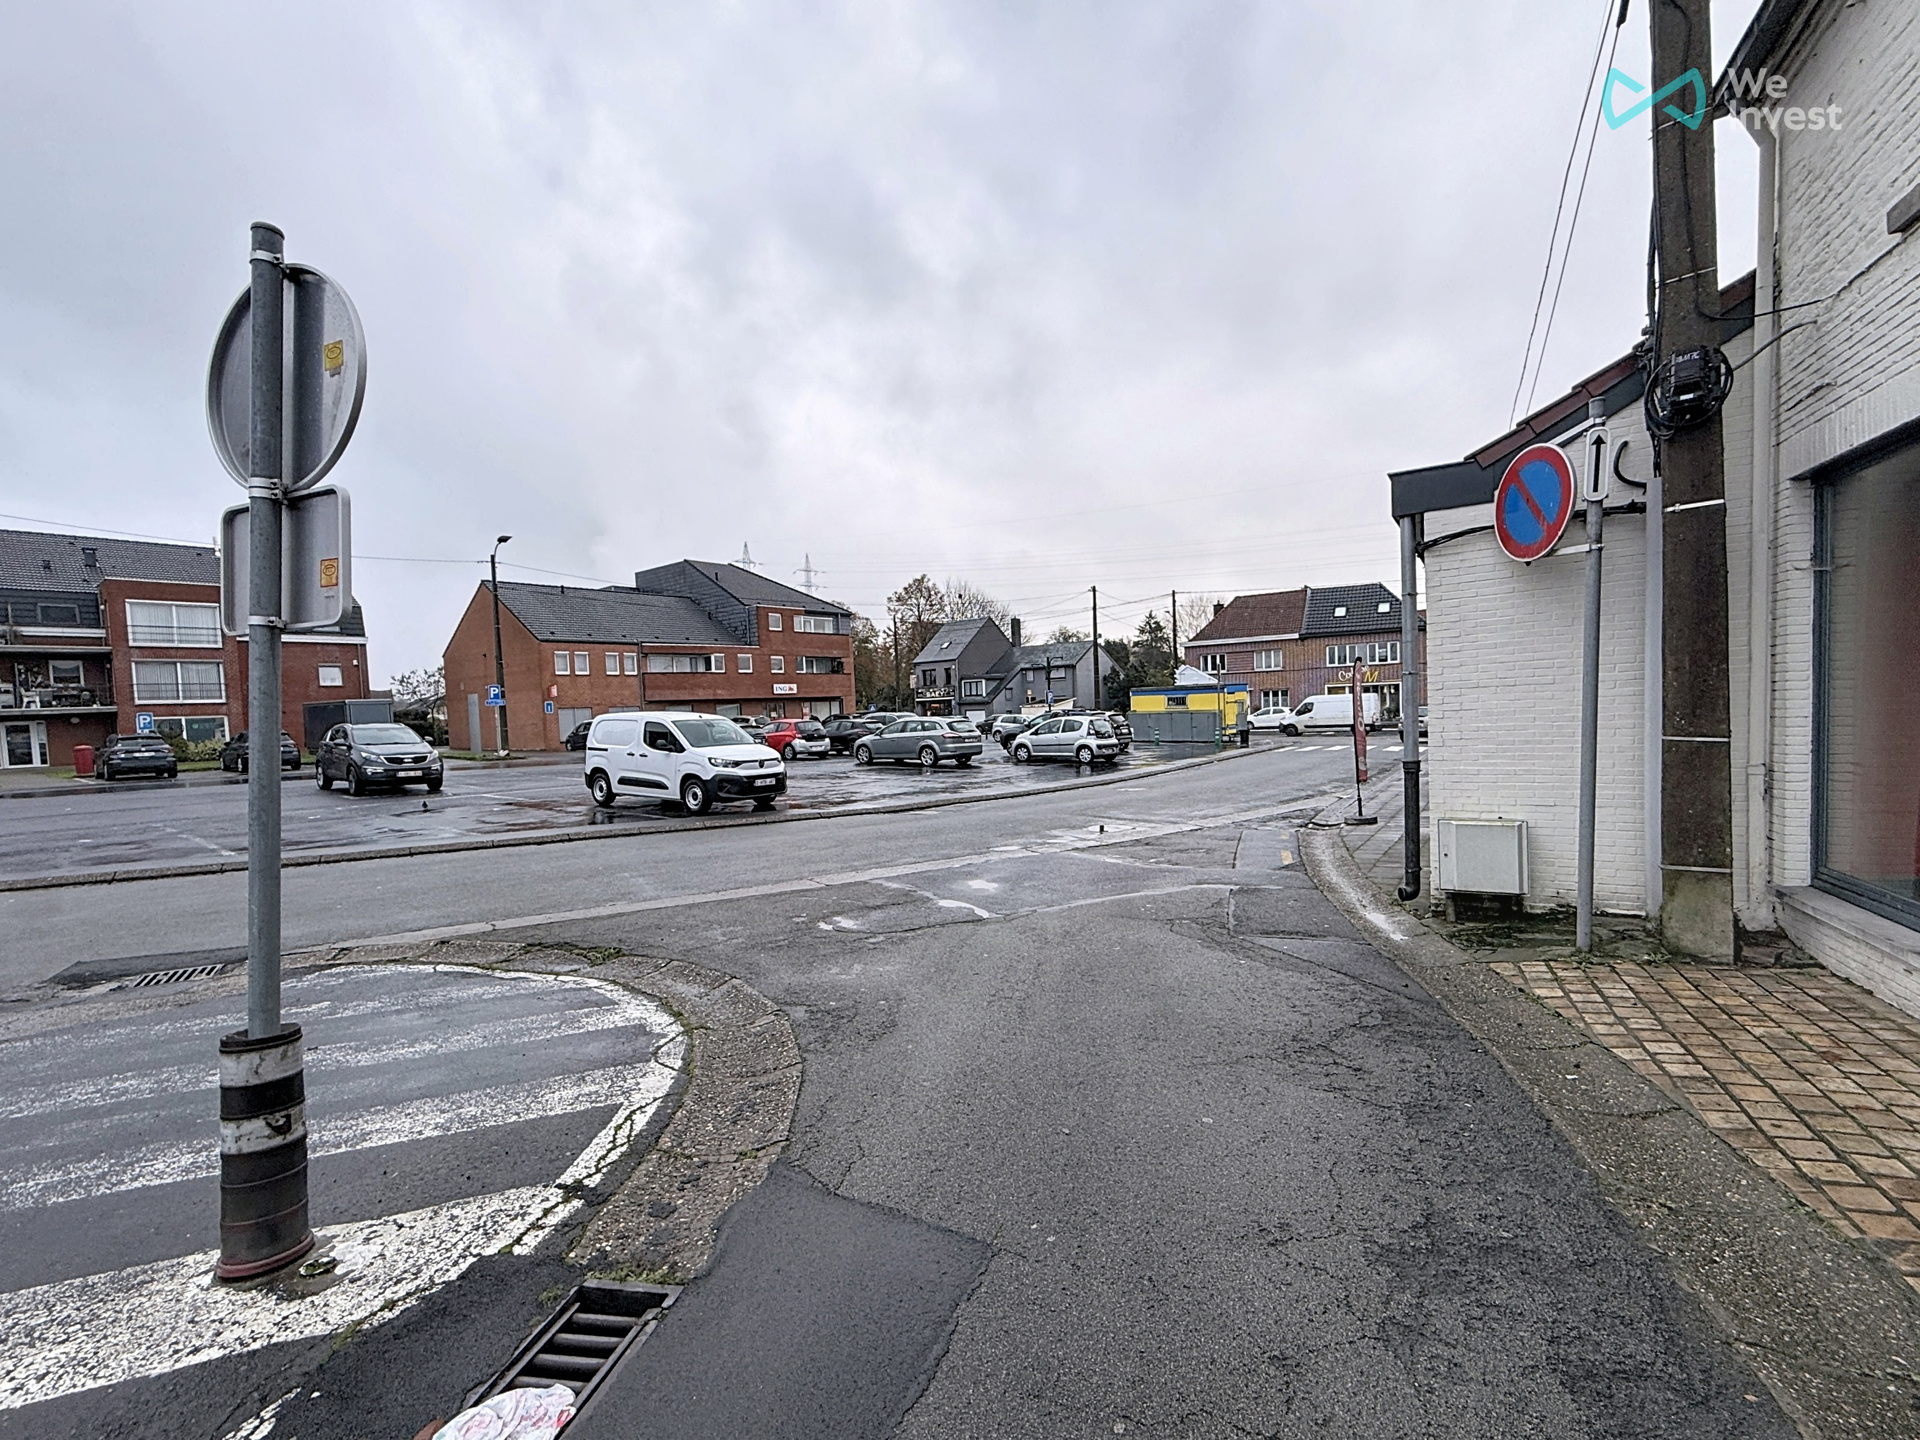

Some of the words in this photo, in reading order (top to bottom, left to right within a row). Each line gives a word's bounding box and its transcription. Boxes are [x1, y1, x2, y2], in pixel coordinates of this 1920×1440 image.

[1364, 670, 1379, 683] M
[490, 687, 499, 698] P
[140, 715, 151, 728] P
